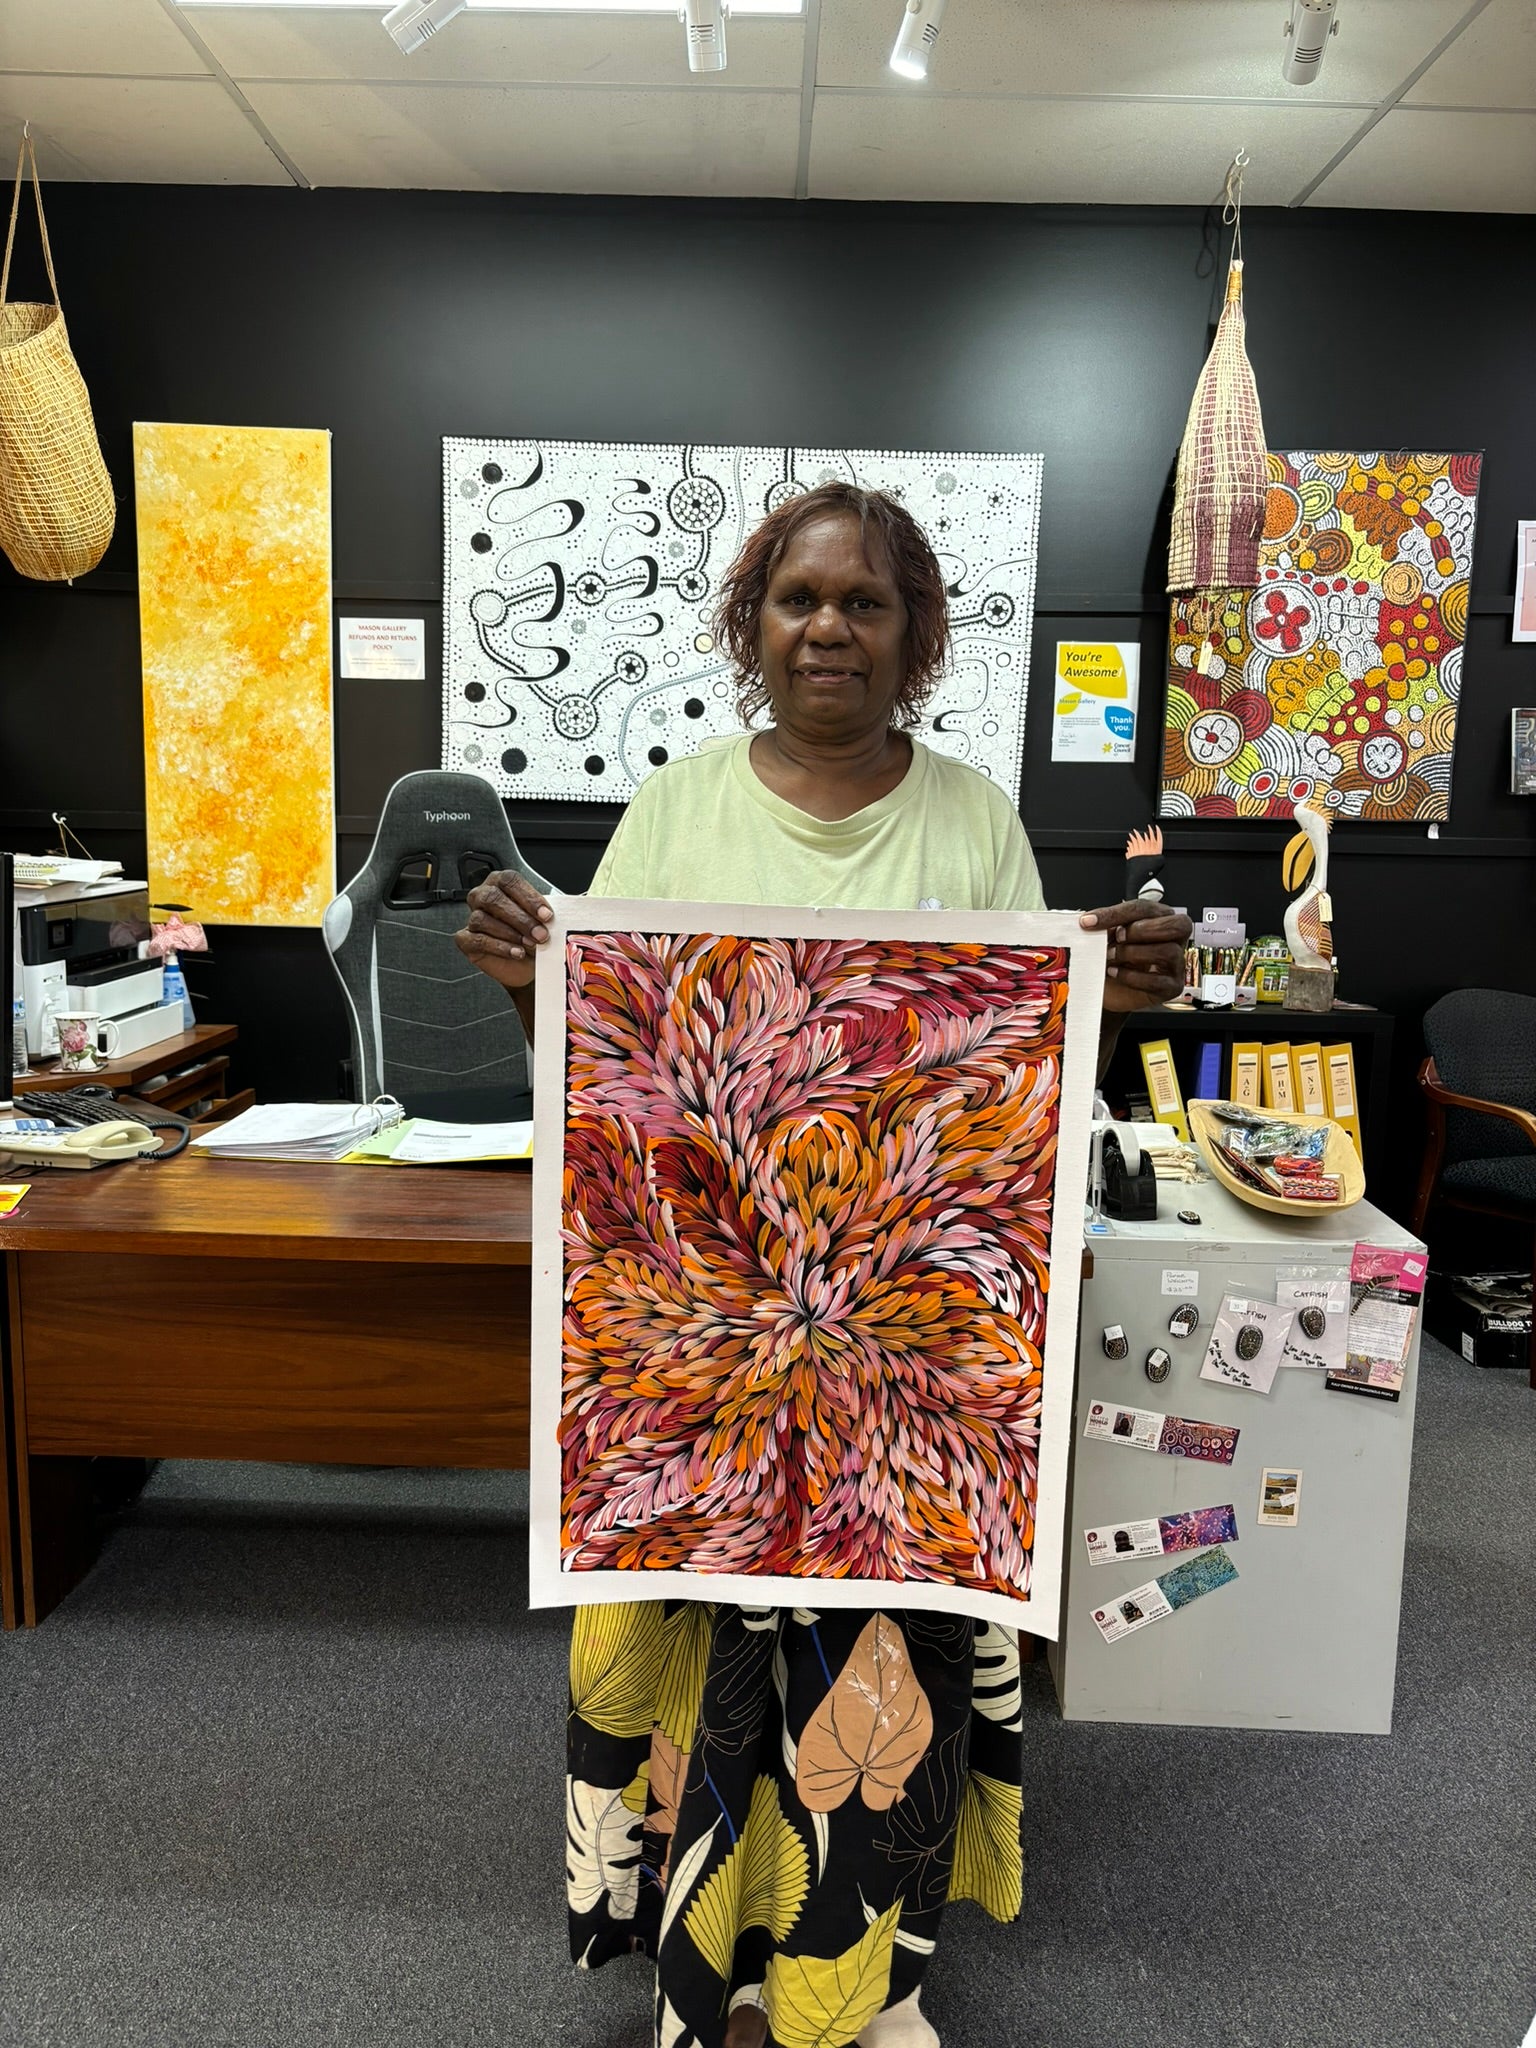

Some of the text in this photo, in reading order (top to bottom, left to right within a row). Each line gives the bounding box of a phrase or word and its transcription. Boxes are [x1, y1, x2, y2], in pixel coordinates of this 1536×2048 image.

[1066, 651, 1102, 662] You're
[1109, 716, 1133, 724] Thank
[423, 810, 471, 823] Typhoon
[1243, 1078, 1250, 1086] A
[1243, 1088, 1250, 1096] G
[1278, 1091, 1286, 1099] M
[1293, 1290, 1329, 1299] CATFISH
[1488, 1319, 1524, 1327] BULLDOG
